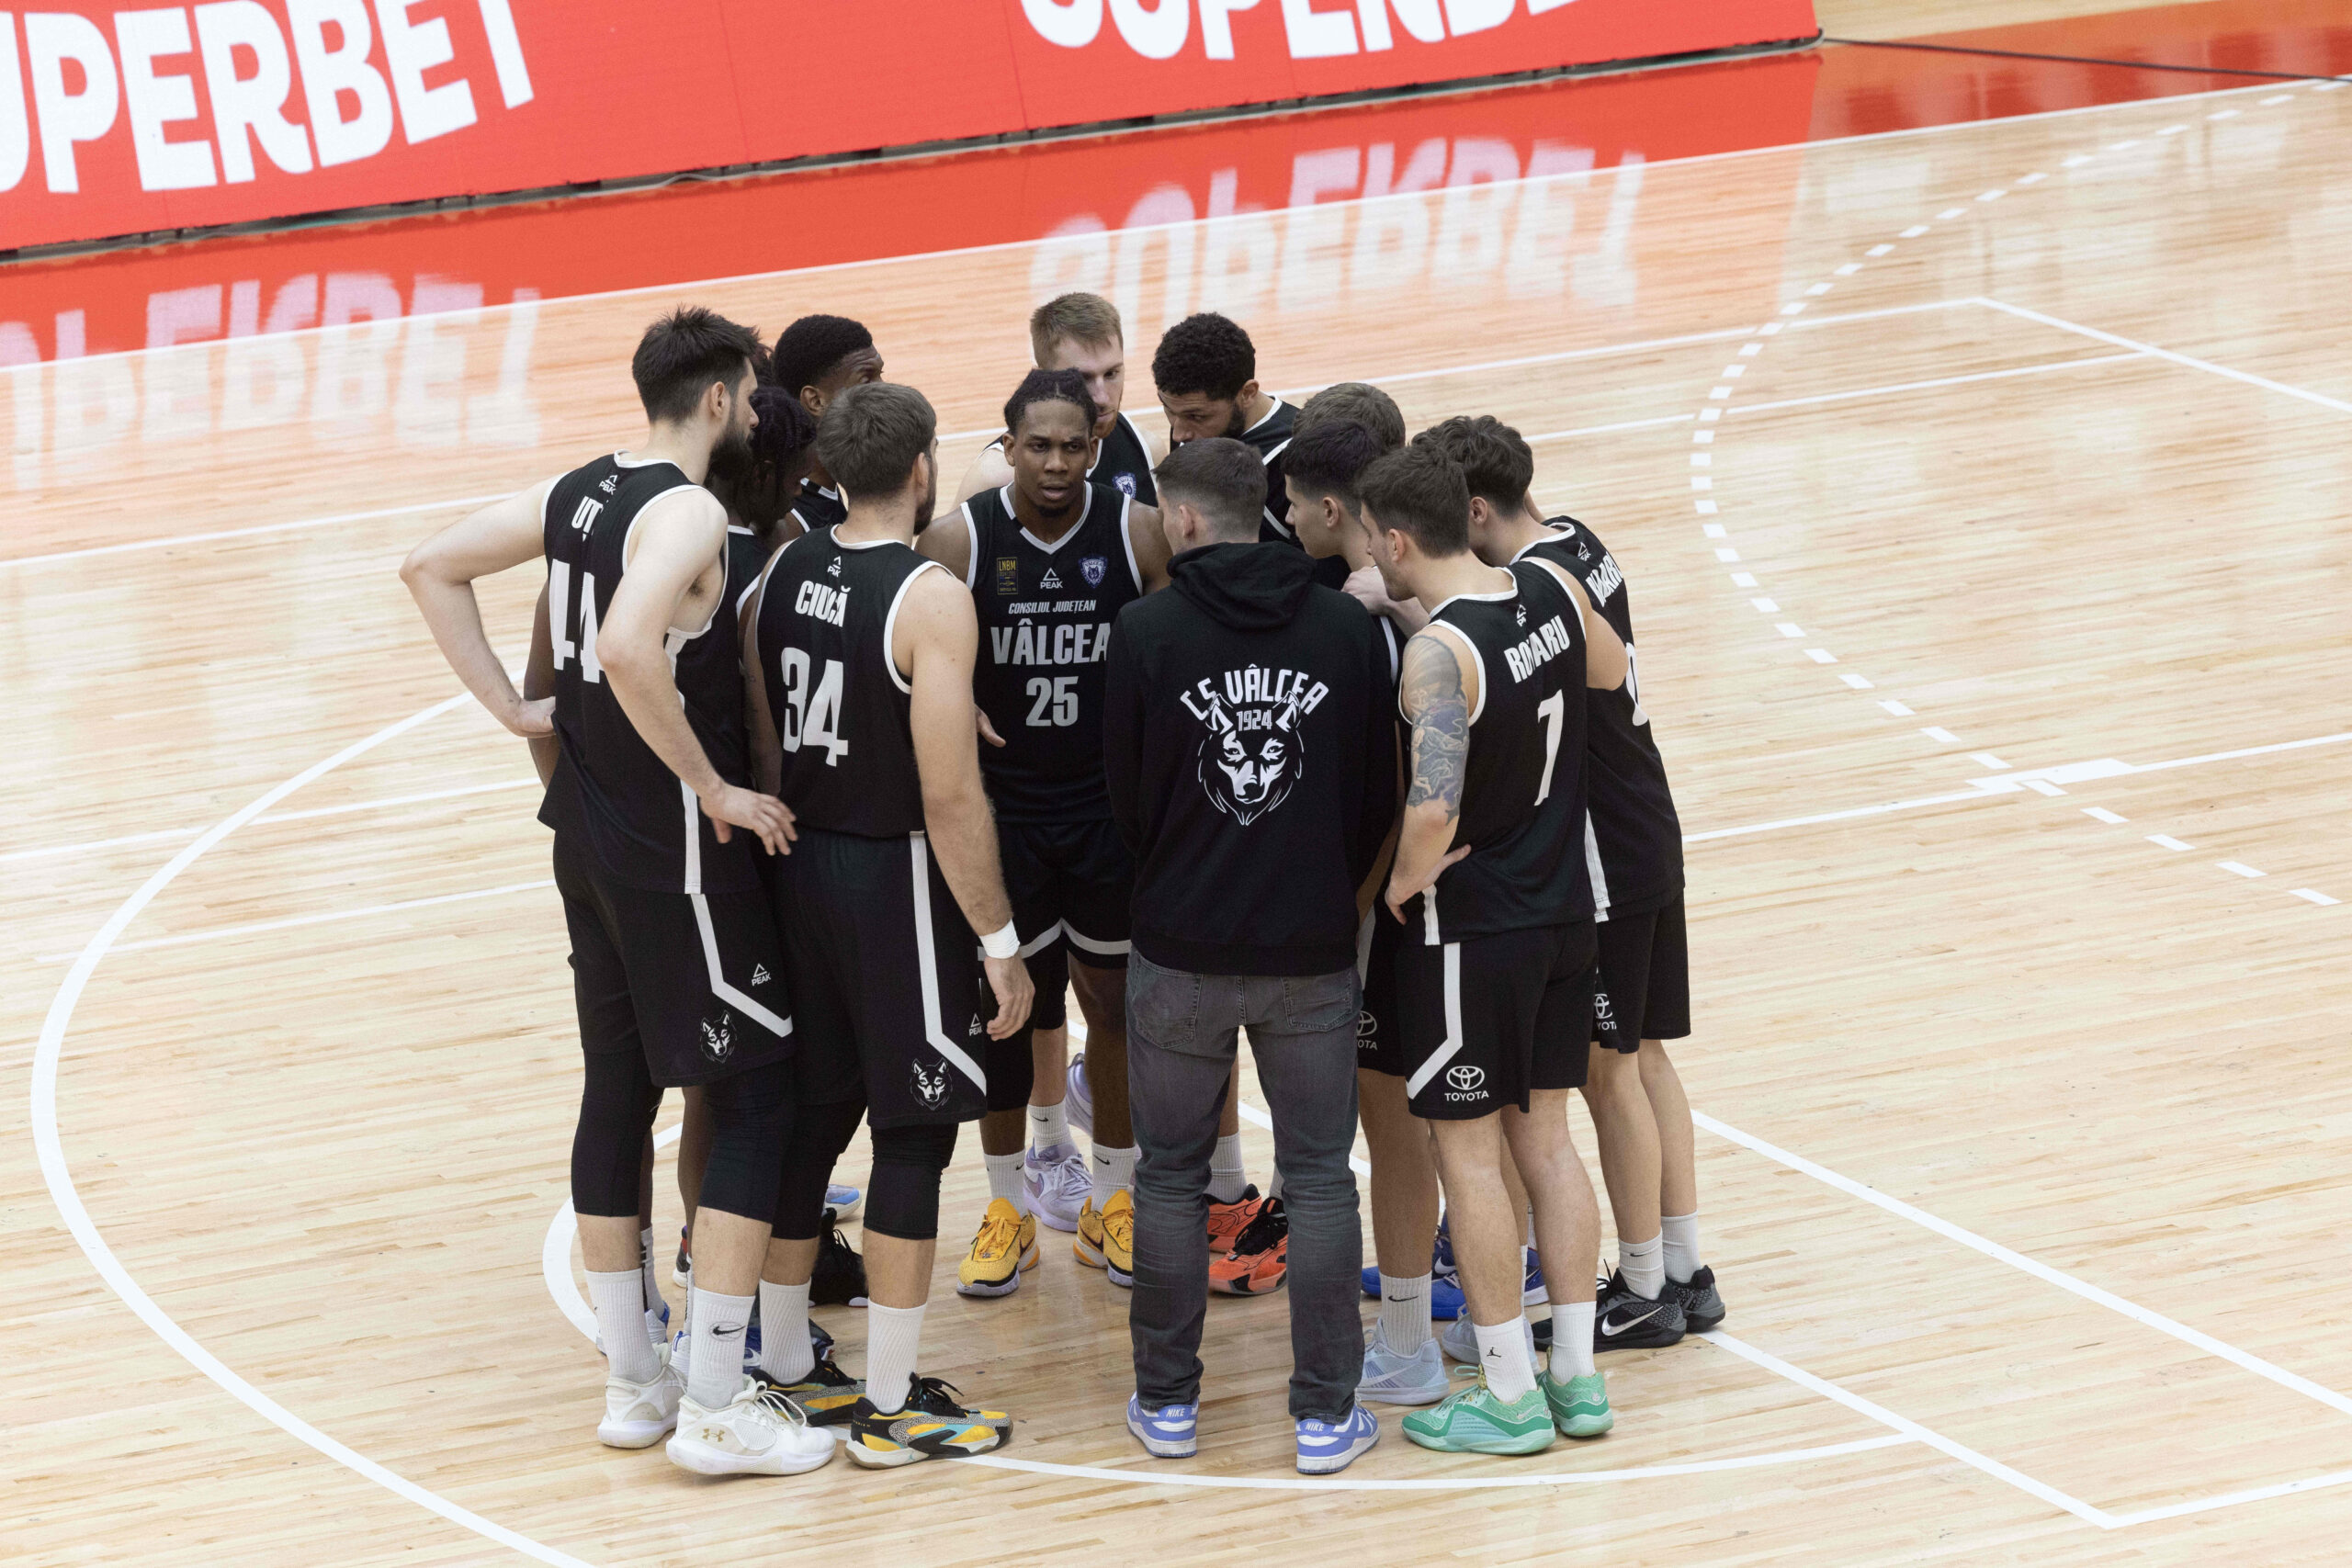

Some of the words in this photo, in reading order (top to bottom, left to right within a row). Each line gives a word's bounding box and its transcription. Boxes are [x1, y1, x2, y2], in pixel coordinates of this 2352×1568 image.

[795, 581, 851, 627] CIUCĂ
[1009, 602, 1050, 614] CONSILIUL
[1053, 600, 1096, 614] JUDEȚEAN
[990, 618, 1111, 665] VÂLCEA
[1225, 663, 1329, 715] VÂLCEA
[781, 647, 848, 767] 34
[1025, 676, 1079, 727] 25
[1236, 709, 1272, 731] 1924
[752, 973, 771, 987] PEAK
[1444, 1090, 1489, 1101] TOYOTA
[1166, 1407, 1185, 1417] NIKE
[1306, 1423, 1324, 1431] NIKE
